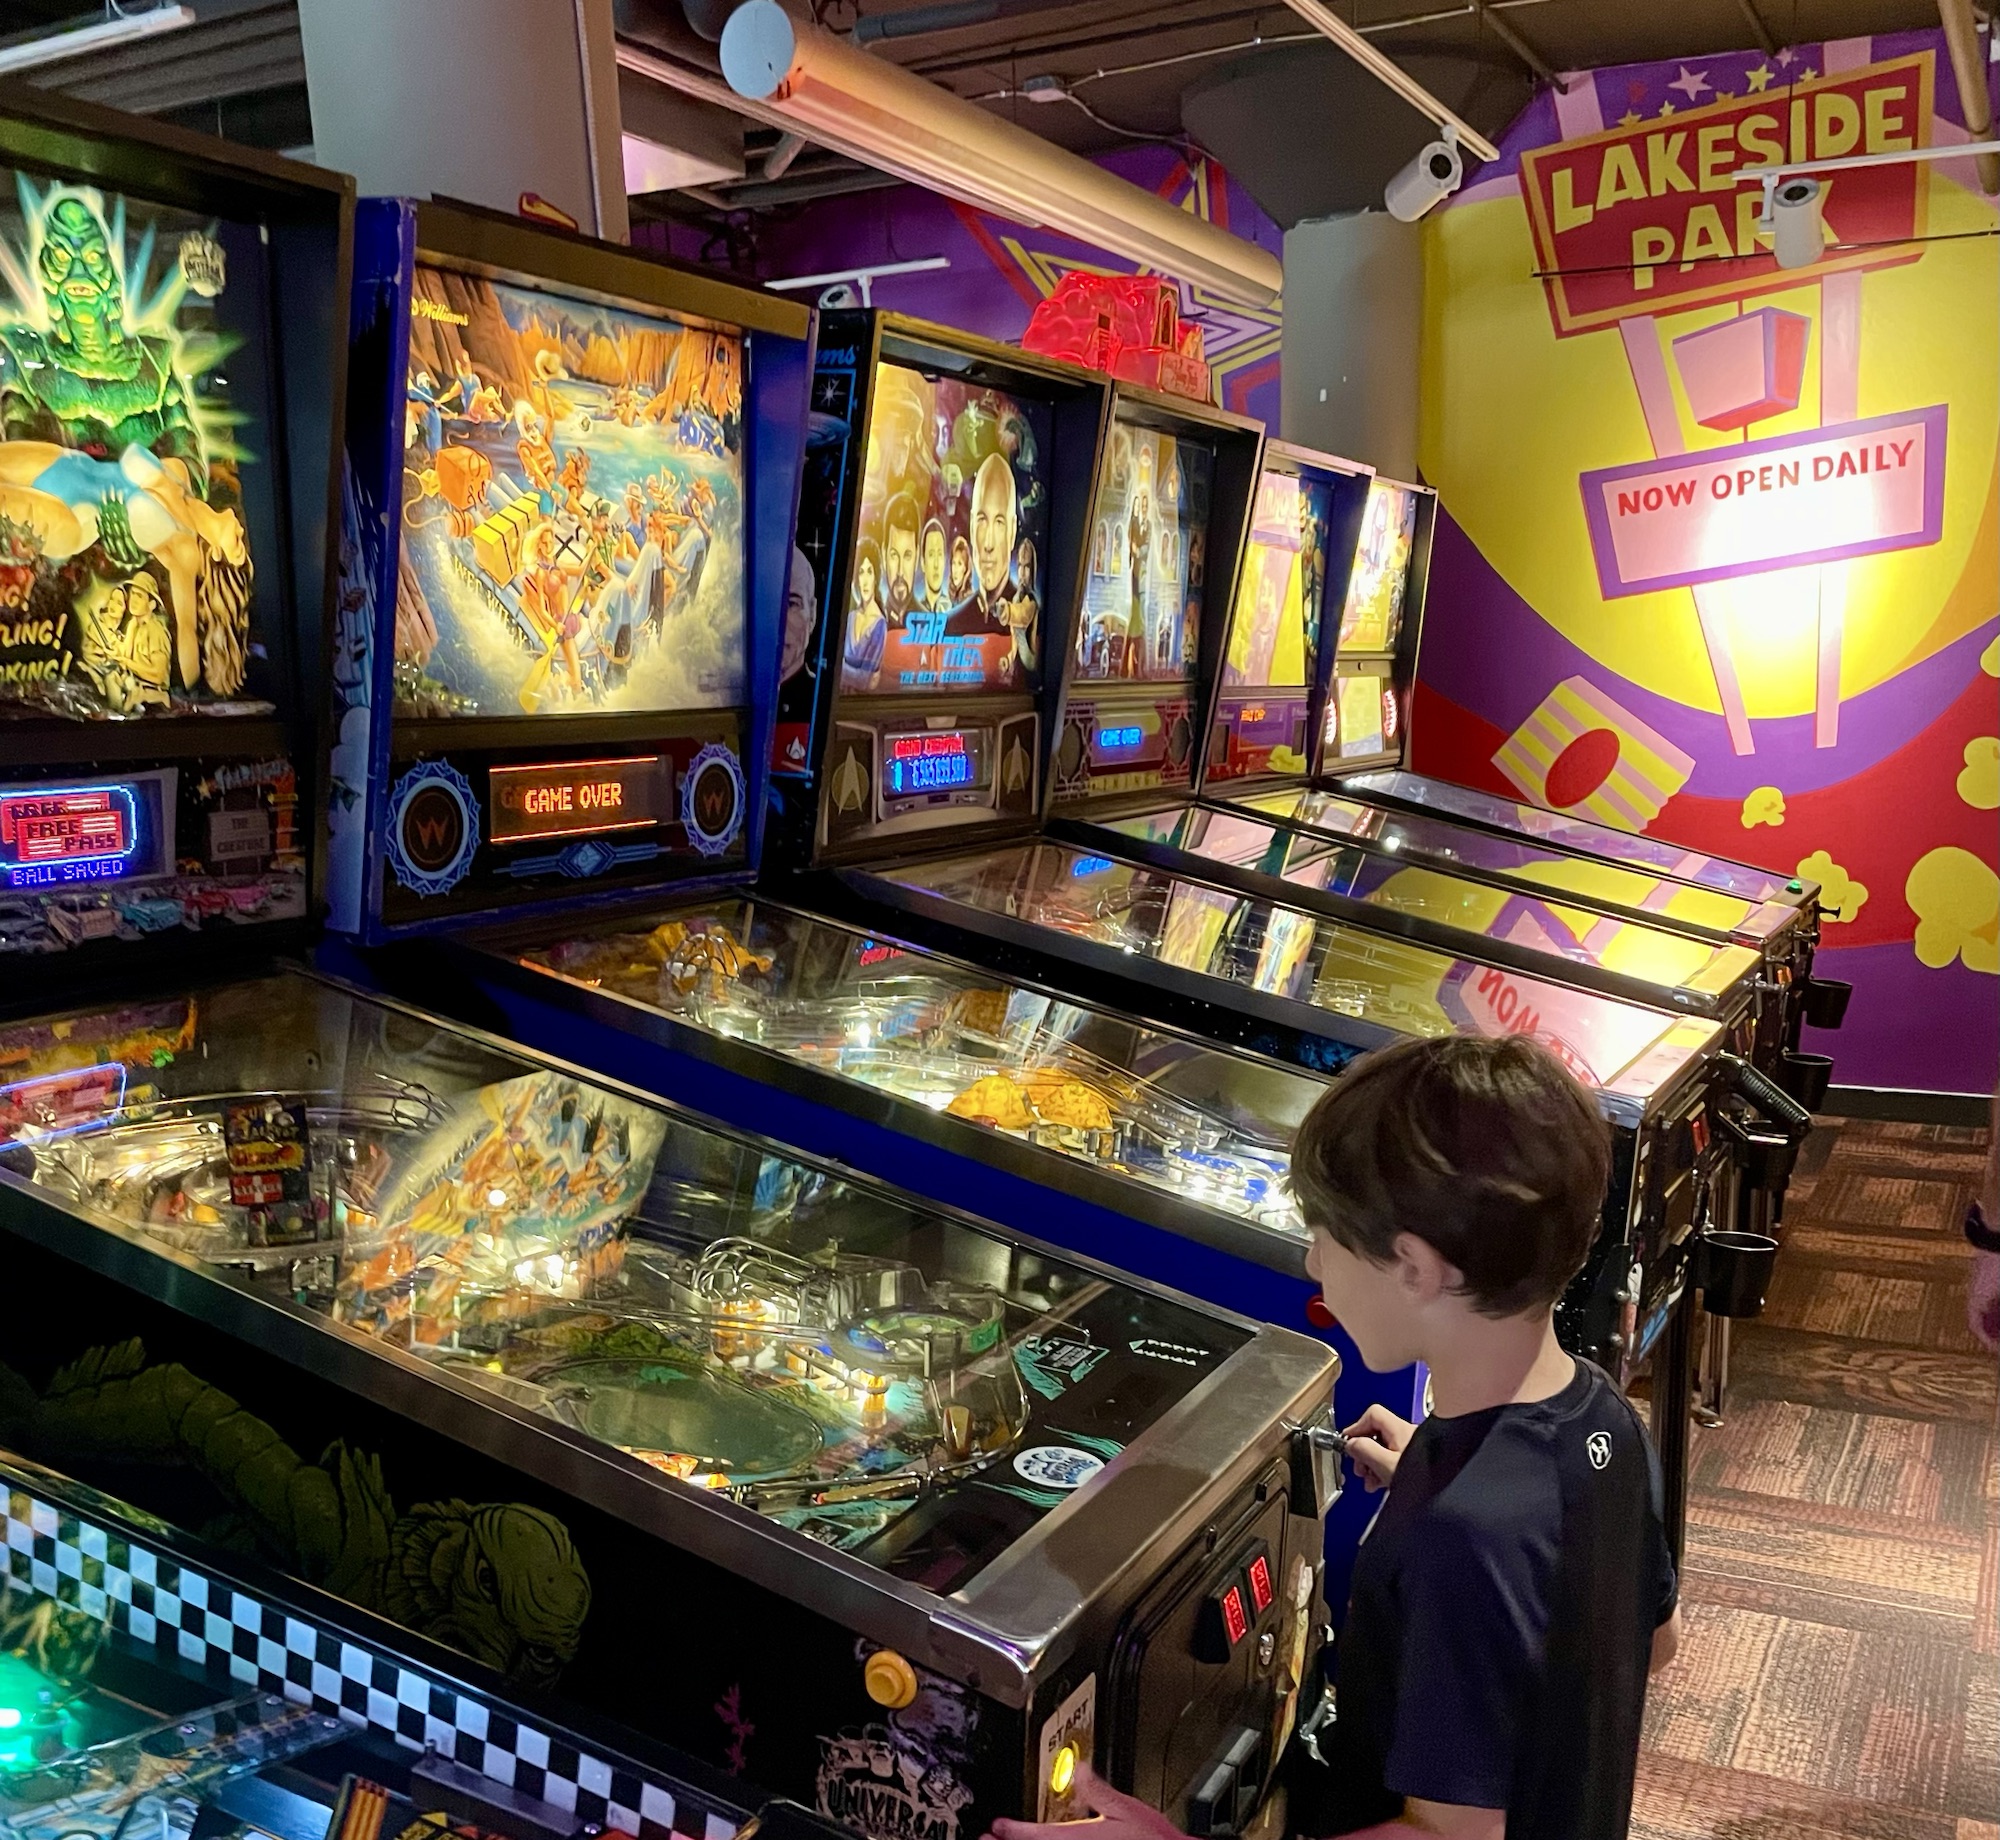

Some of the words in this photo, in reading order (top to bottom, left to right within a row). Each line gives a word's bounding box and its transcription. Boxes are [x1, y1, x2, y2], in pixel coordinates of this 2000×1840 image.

[1552, 86, 1913, 234] LAKESIDE
[421, 299, 469, 327] Williams
[1618, 480, 1697, 517] NOW
[1711, 461, 1800, 500] OPEN
[1813, 440, 1915, 482] DAILY
[900, 611, 949, 645] STAR
[524, 786, 573, 815] GAME
[579, 782, 622, 809] OVER
[27, 820, 79, 838] FREE
[64, 833, 117, 852] PASS
[13, 866, 57, 886] BALL
[63, 859, 123, 880] SAVED
[1048, 1699, 1088, 1752] START
